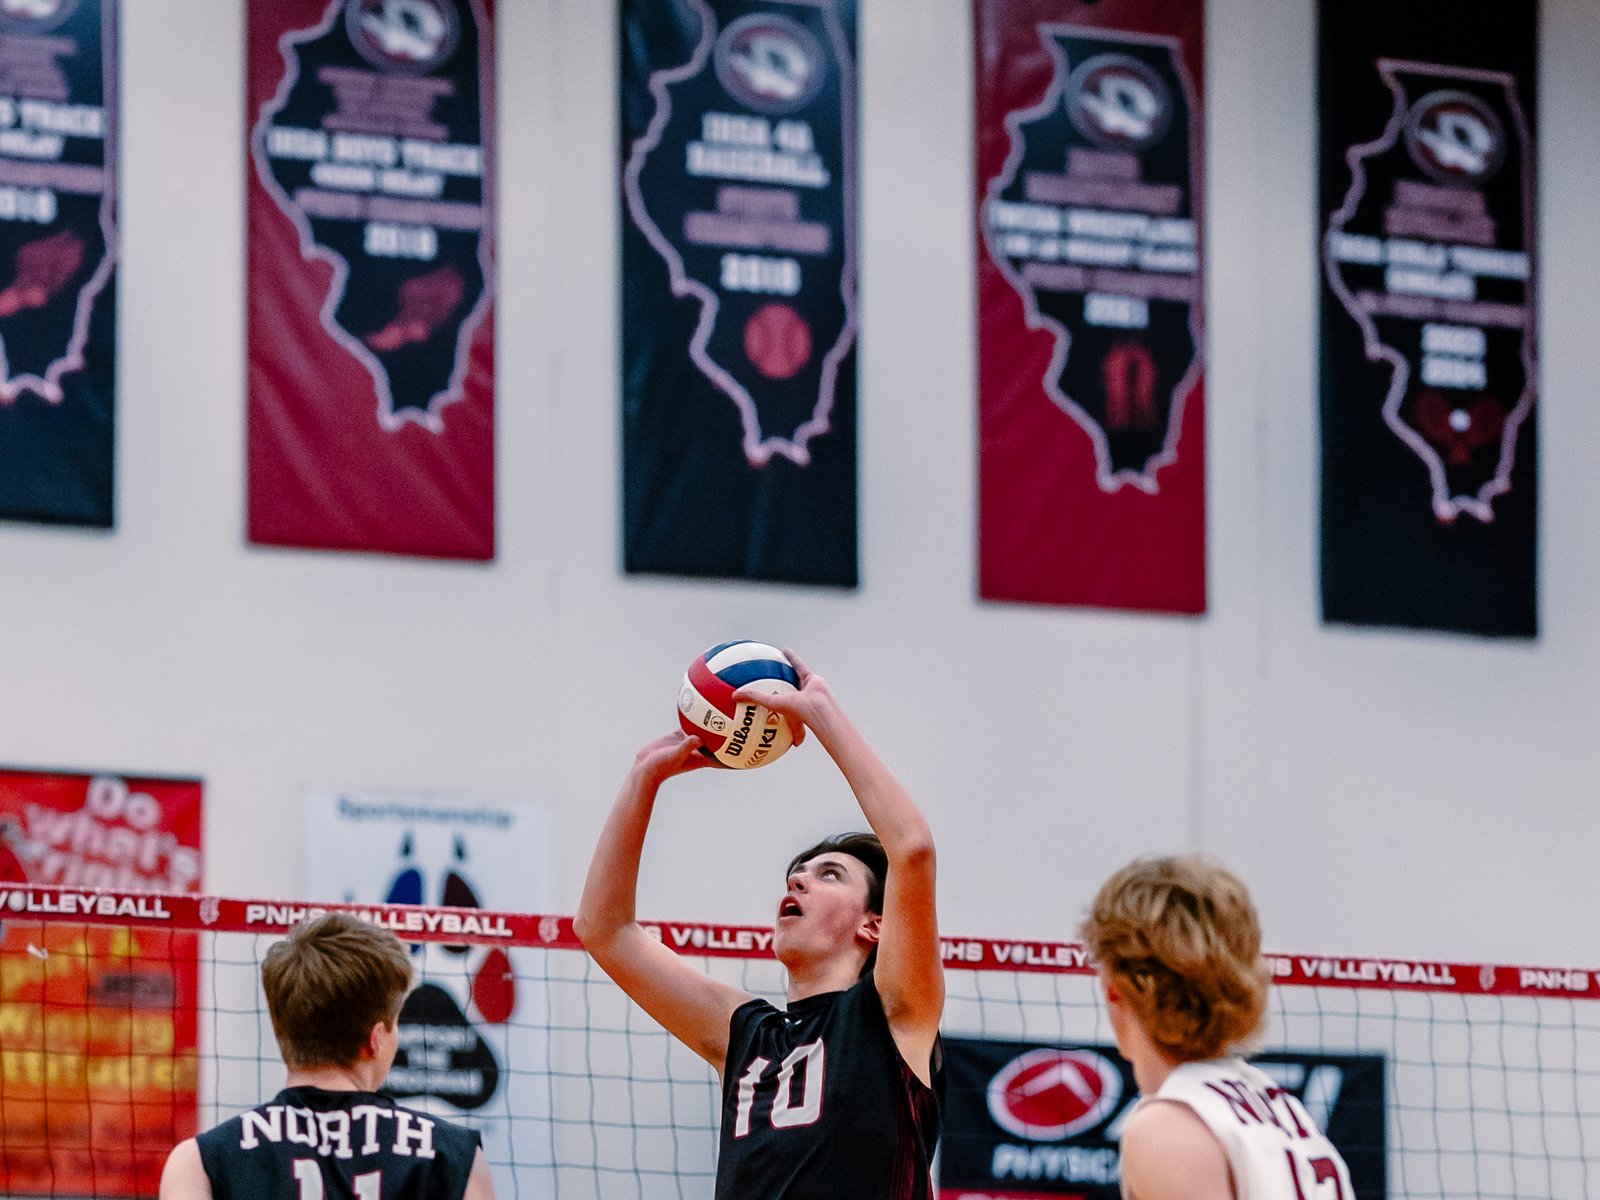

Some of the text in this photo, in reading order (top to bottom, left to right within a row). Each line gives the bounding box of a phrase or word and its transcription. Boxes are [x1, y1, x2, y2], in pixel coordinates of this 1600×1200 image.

[725, 705, 756, 757] Wilson
[86, 776, 160, 829] Do
[338, 909, 513, 937] OLLEYBALL
[669, 927, 773, 951] VOLLEY
[992, 944, 1088, 968] VOLLEY
[1299, 959, 1456, 986] VOLLEYBALL
[1520, 969, 1589, 992] PNHS
[734, 1036, 825, 1139] 10
[240, 1105, 436, 1159] NORTH
[991, 1142, 1120, 1184] PHYSIC
